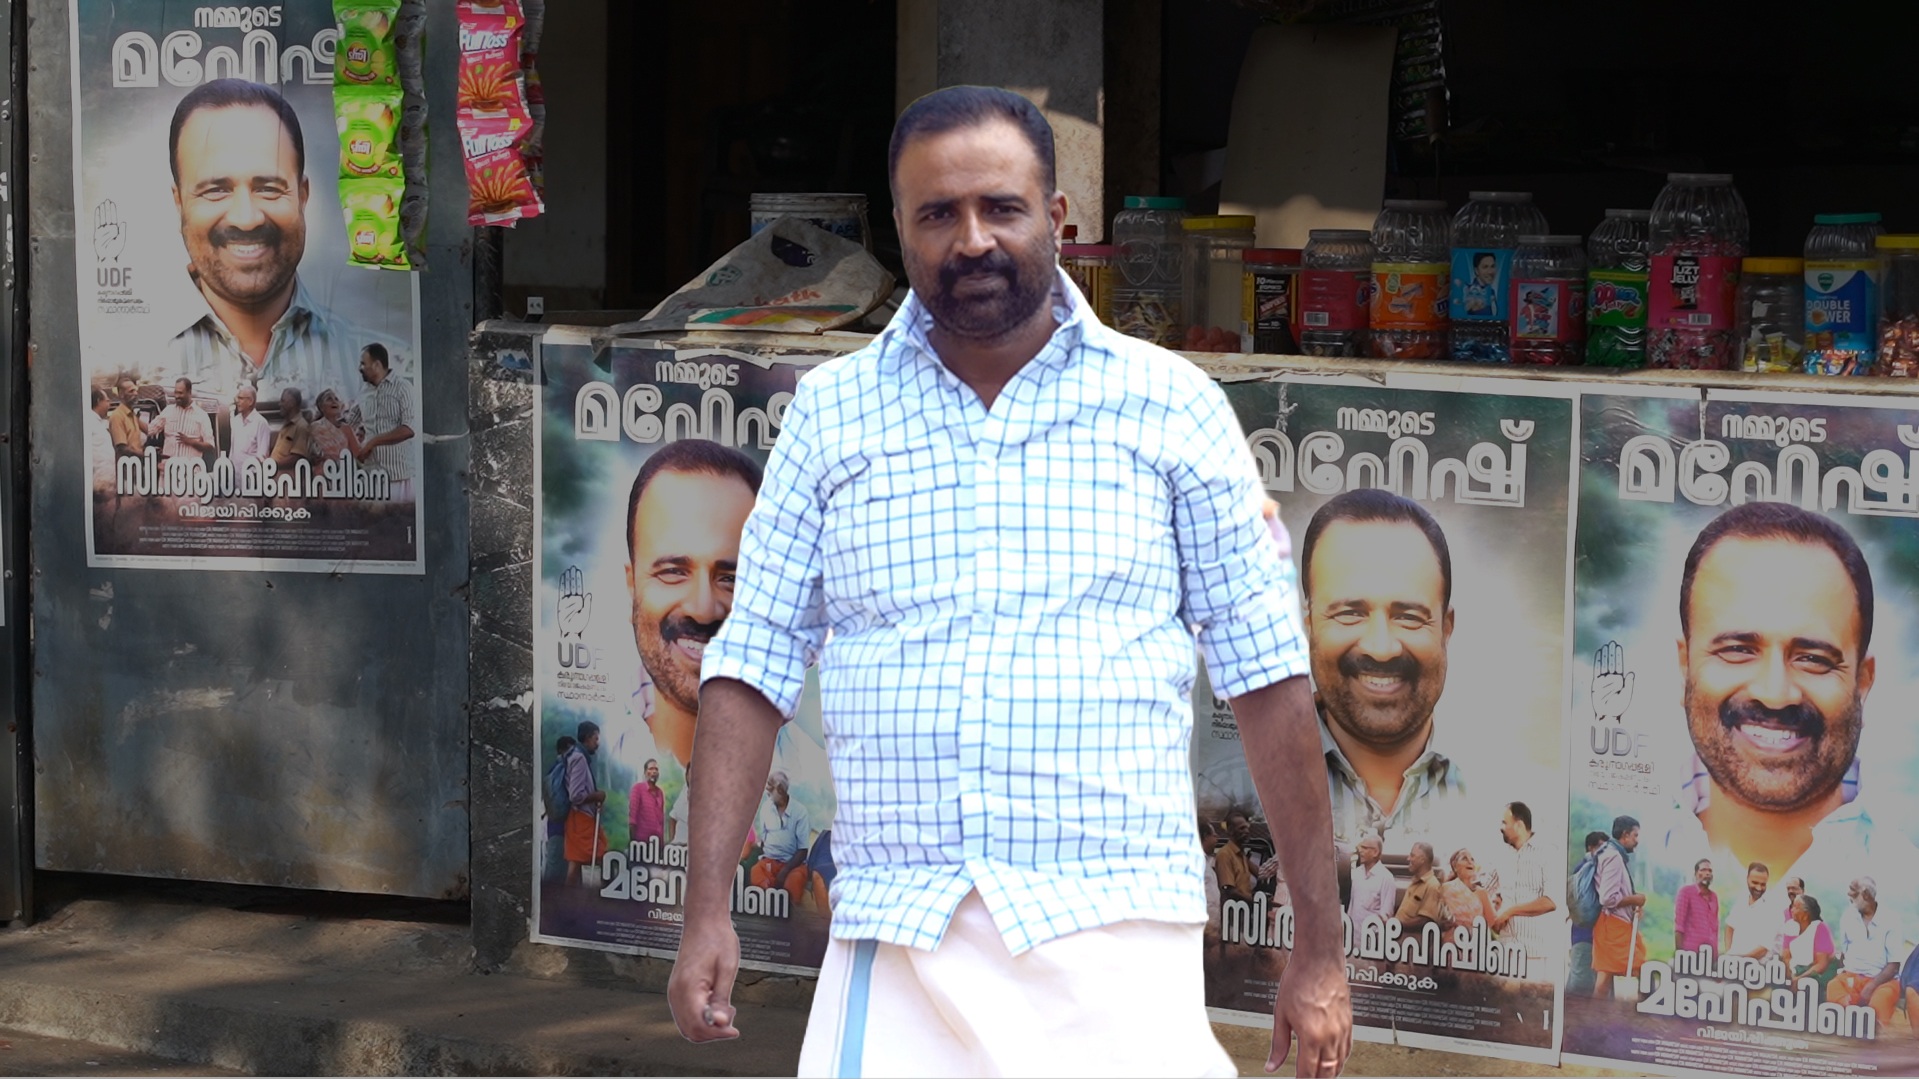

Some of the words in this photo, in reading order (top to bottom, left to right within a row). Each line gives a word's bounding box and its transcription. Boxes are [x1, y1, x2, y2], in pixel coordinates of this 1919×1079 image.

[195, 6, 282, 33] നമ്മുടെ
[112, 28, 335, 88] മഹേഷ
[97, 267, 132, 288] UDF
[1806, 300, 1851, 311] DOUBLE
[655, 360, 740, 390] നമ്മുടെ
[1337, 406, 1436, 440] നമ്മുടെ
[1721, 413, 1827, 447] നമ്മുടെ
[178, 502, 312, 521] വിജയിപ്പിക്കുക
[558, 641, 604, 670] UDF
[1590, 725, 1650, 758] UDF
[1637, 961, 1876, 1040] മഹേഷിനെ
